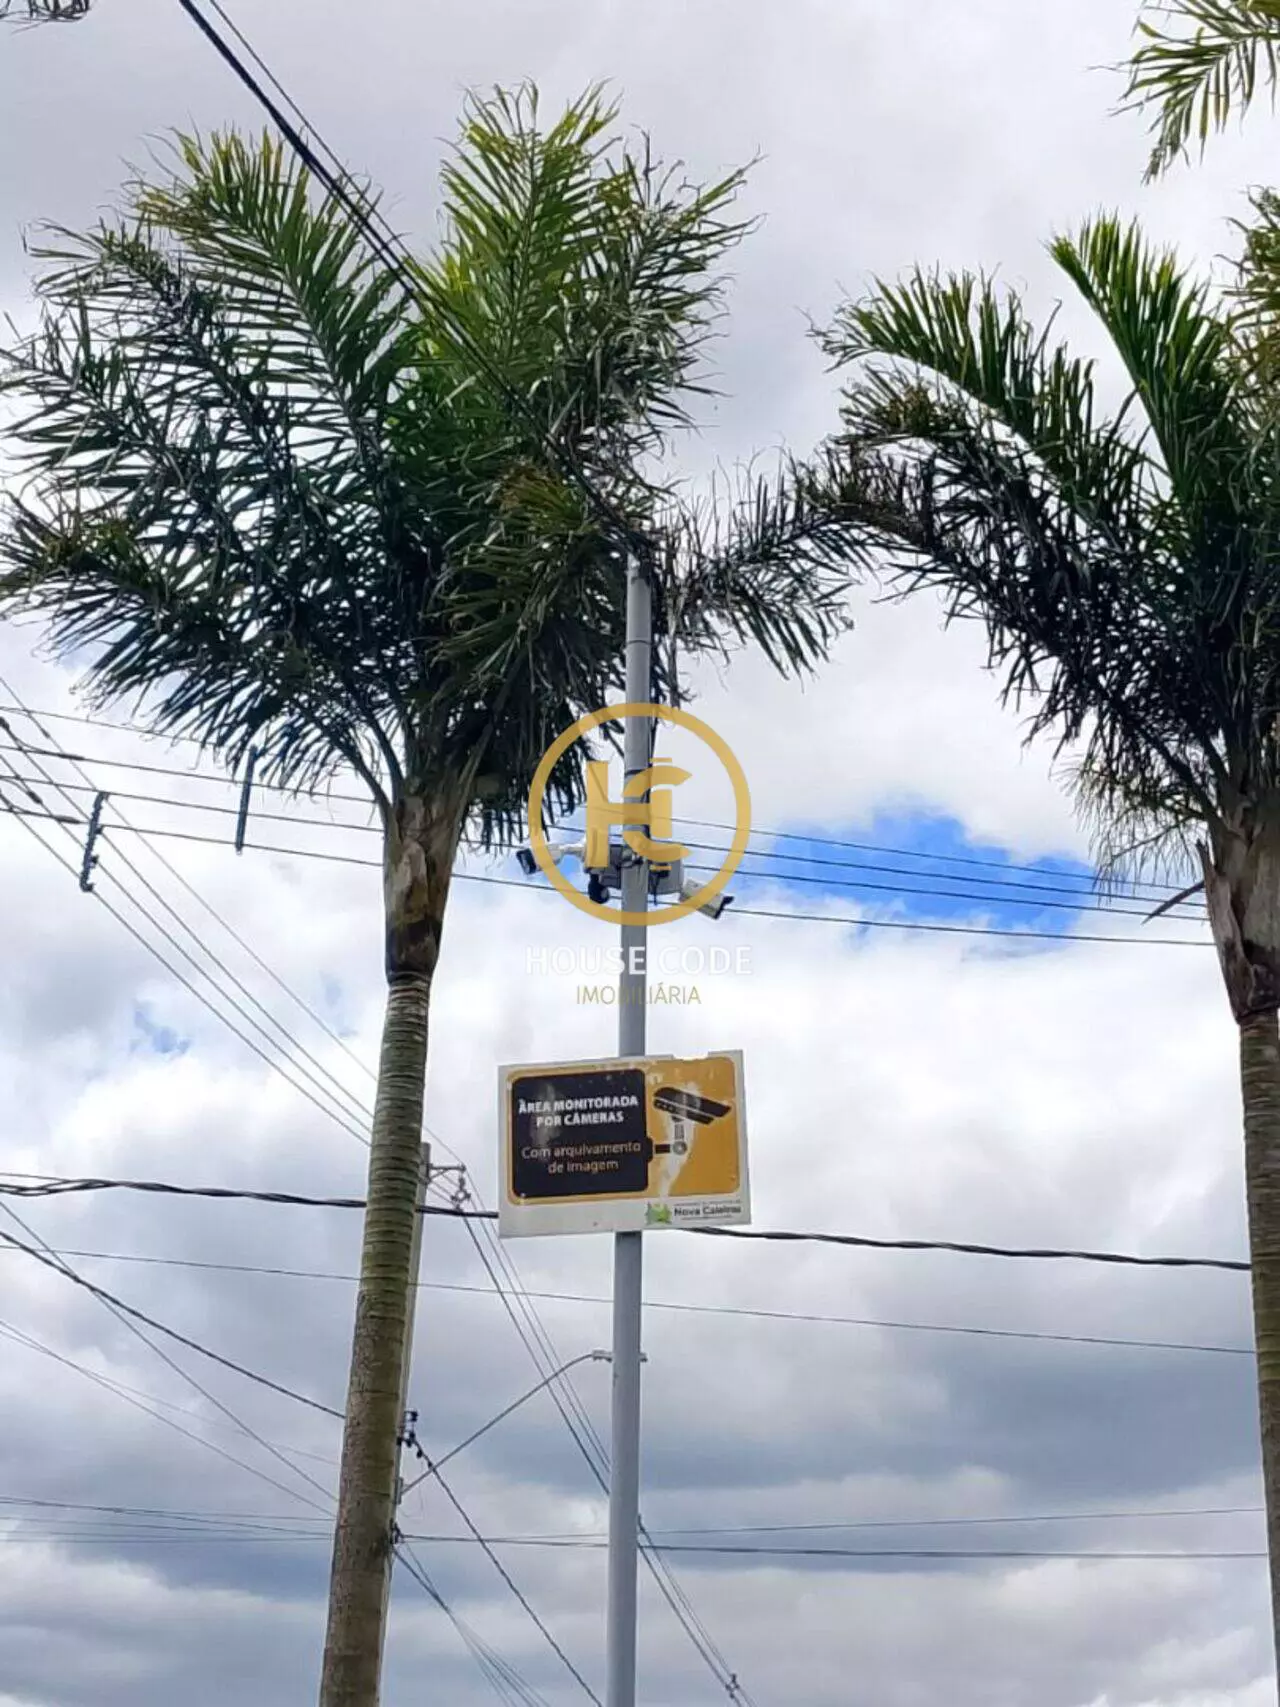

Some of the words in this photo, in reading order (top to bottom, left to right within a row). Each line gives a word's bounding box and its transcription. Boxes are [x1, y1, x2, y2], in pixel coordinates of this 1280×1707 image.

[554, 1096, 639, 1112] MONITORADA
[537, 1115, 561, 1127] POR
[564, 1111, 624, 1125] CÂMERAS
[521, 1146, 551, 1160] Com
[554, 1142, 641, 1158] arquivamento
[548, 1162, 563, 1174] de
[567, 1160, 618, 1174] imagem
